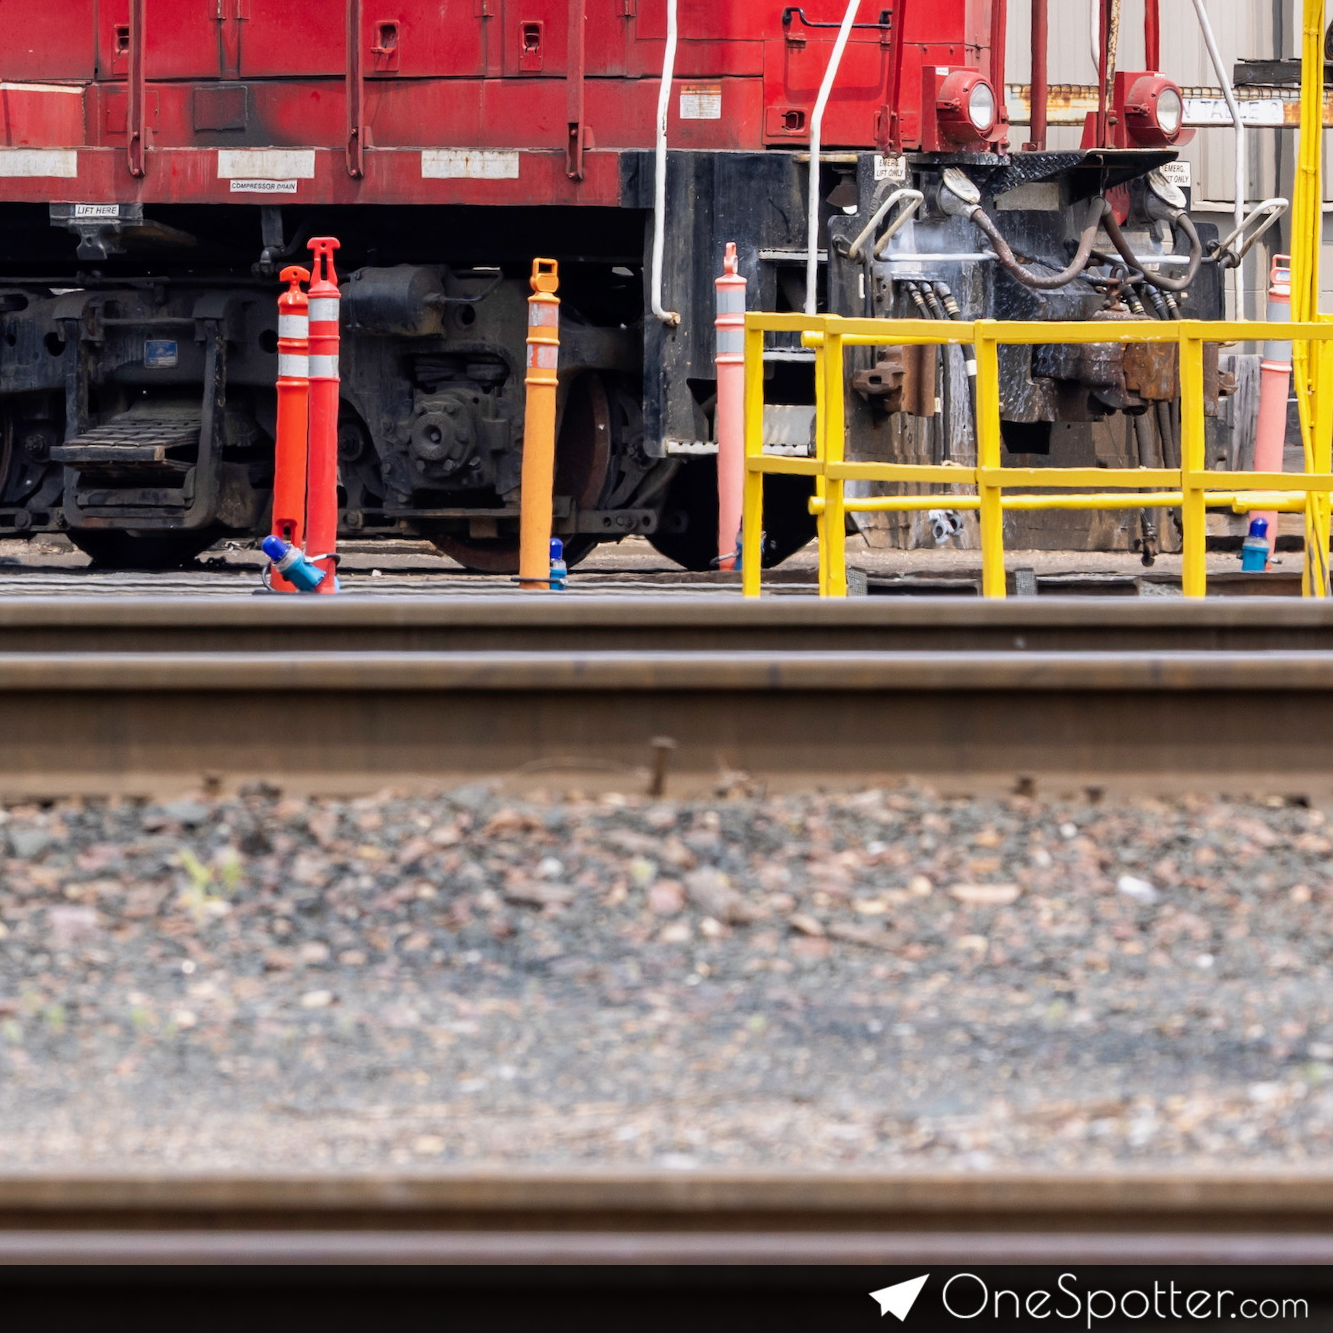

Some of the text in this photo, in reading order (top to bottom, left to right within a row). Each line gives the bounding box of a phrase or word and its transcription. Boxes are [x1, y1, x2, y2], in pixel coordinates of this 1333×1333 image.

[1164, 164, 1186, 173] EMERG.
[1173, 175, 1189, 183] ONLY
[231, 182, 276, 190] COMPRESSOR
[77, 206, 118, 215] LIFT HERE
